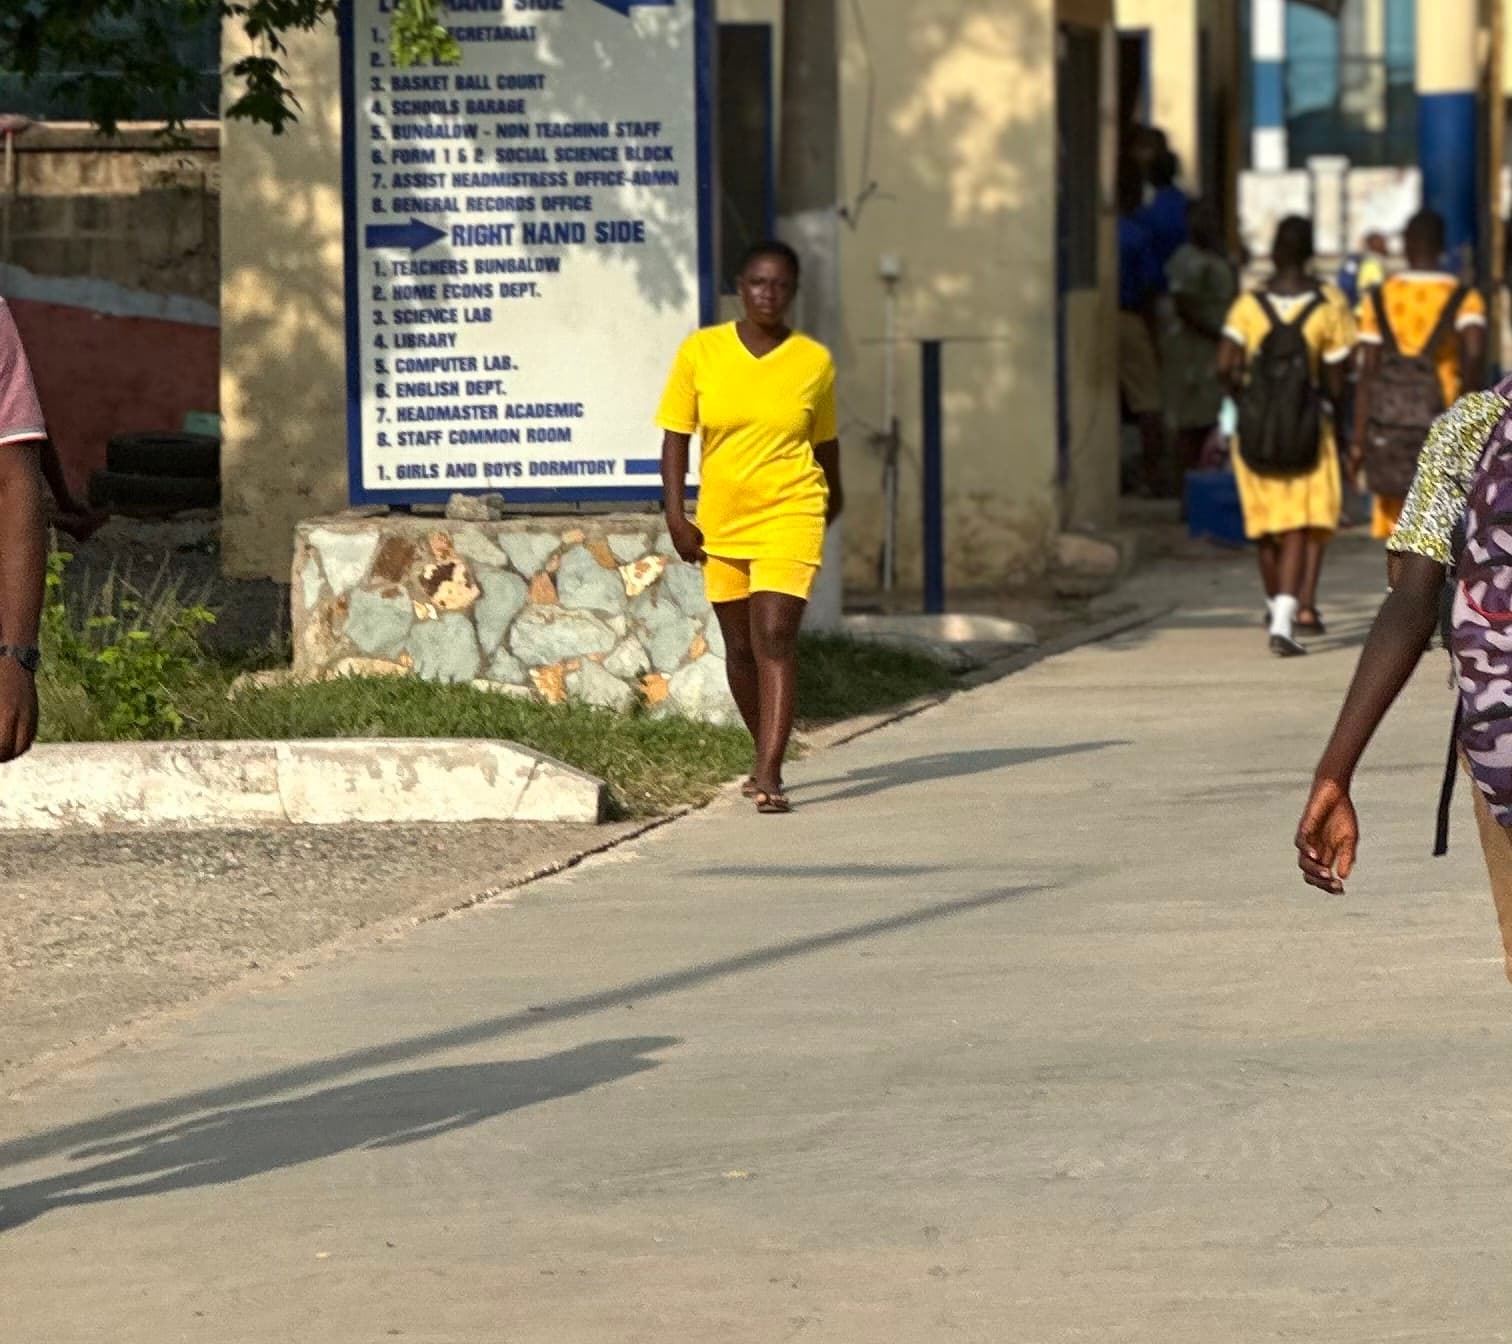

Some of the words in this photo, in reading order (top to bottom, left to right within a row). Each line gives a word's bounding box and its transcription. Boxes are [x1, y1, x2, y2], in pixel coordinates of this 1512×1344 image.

[391, 76, 448, 91] BASKET
[455, 75, 491, 90] BALL
[496, 74, 545, 90] COURT
[392, 100, 460, 115] SCHOOLS
[466, 99, 525, 115] GARAGE
[392, 123, 478, 140] BUNGALOW
[496, 123, 529, 138] NON
[536, 122, 609, 138] TEACHING
[616, 122, 660, 137] STAFF
[391, 148, 435, 164] FORM
[496, 148, 548, 163] SOCIAL
[555, 147, 618, 162] SCIENCE
[625, 146, 673, 161] BLOCK
[392, 173, 446, 188] ASSIST
[452, 171, 568, 187] HEADMISTRESS
[392, 197, 459, 213] GENERAL
[466, 196, 536, 212] RECORDS
[541, 196, 592, 211] OFFICE
[452, 224, 514, 246] RIGHT
[522, 222, 585, 244] HAND
[595, 221, 645, 244] SIDE
[392, 260, 468, 276] TEACHERS
[475, 257, 560, 274] BUNGALOW
[393, 284, 436, 300] HOME
[443, 283, 493, 299] ECONS
[393, 308, 457, 324] SCIENCE
[394, 333, 456, 348] LIBRARY
[395, 357, 477, 373] COMPUTER
[396, 382, 459, 397] ENGLISH
[397, 405, 498, 422] HEADMASTER
[505, 403, 583, 419] ACADEMIC
[398, 431, 442, 446] STAFF
[449, 429, 520, 444] COMMON
[527, 427, 571, 442] ROOM
[396, 464, 439, 479] GIRLS
[446, 463, 477, 478] AND
[484, 462, 522, 477] BOYS
[529, 460, 615, 476] DORMITORY
